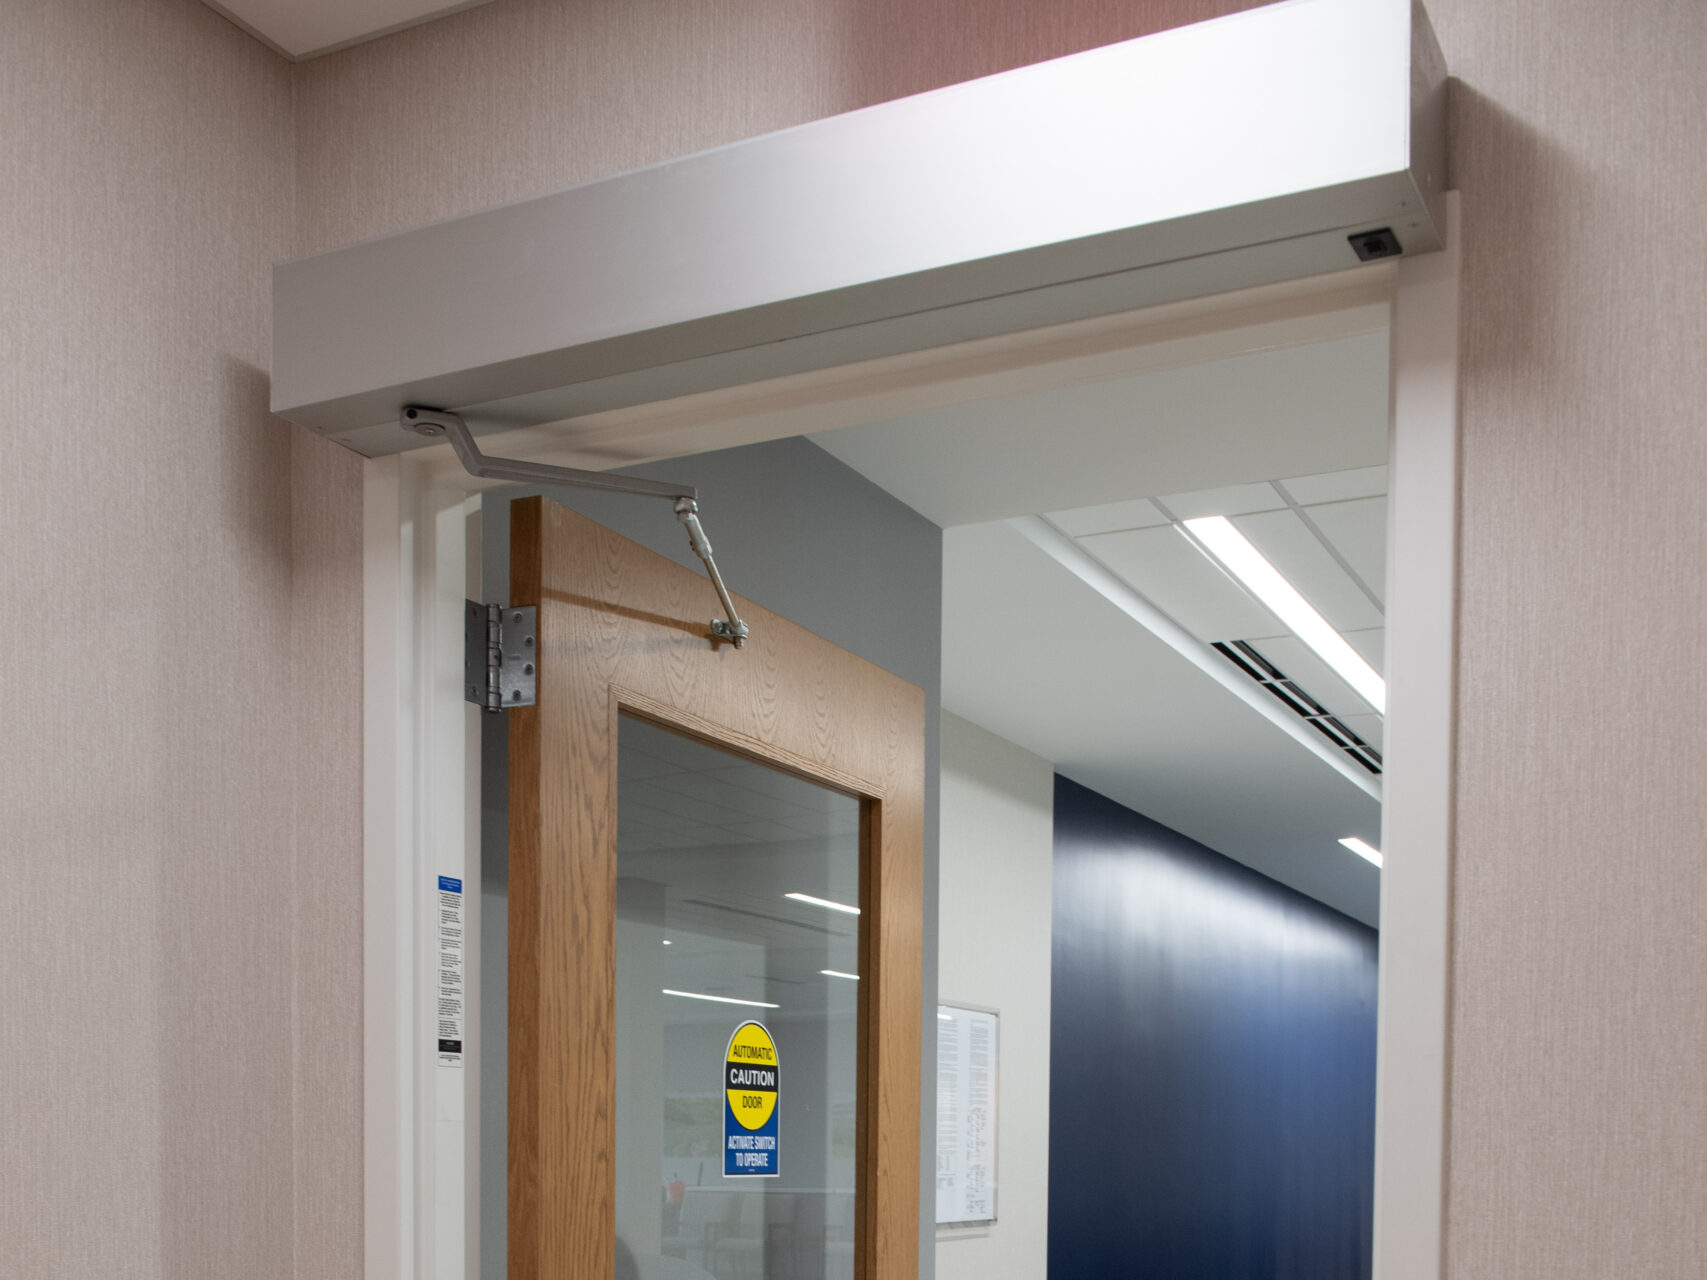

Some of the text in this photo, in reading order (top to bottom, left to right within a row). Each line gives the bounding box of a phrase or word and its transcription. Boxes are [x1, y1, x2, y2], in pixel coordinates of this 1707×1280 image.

[733, 1044, 773, 1060] AUTOMATIC
[730, 1068, 775, 1087] CAUTION
[742, 1096, 763, 1109] DOOR
[728, 1135, 776, 1151] ACTIVATE SWITCH
[735, 1152, 768, 1167] TO OPERATE
